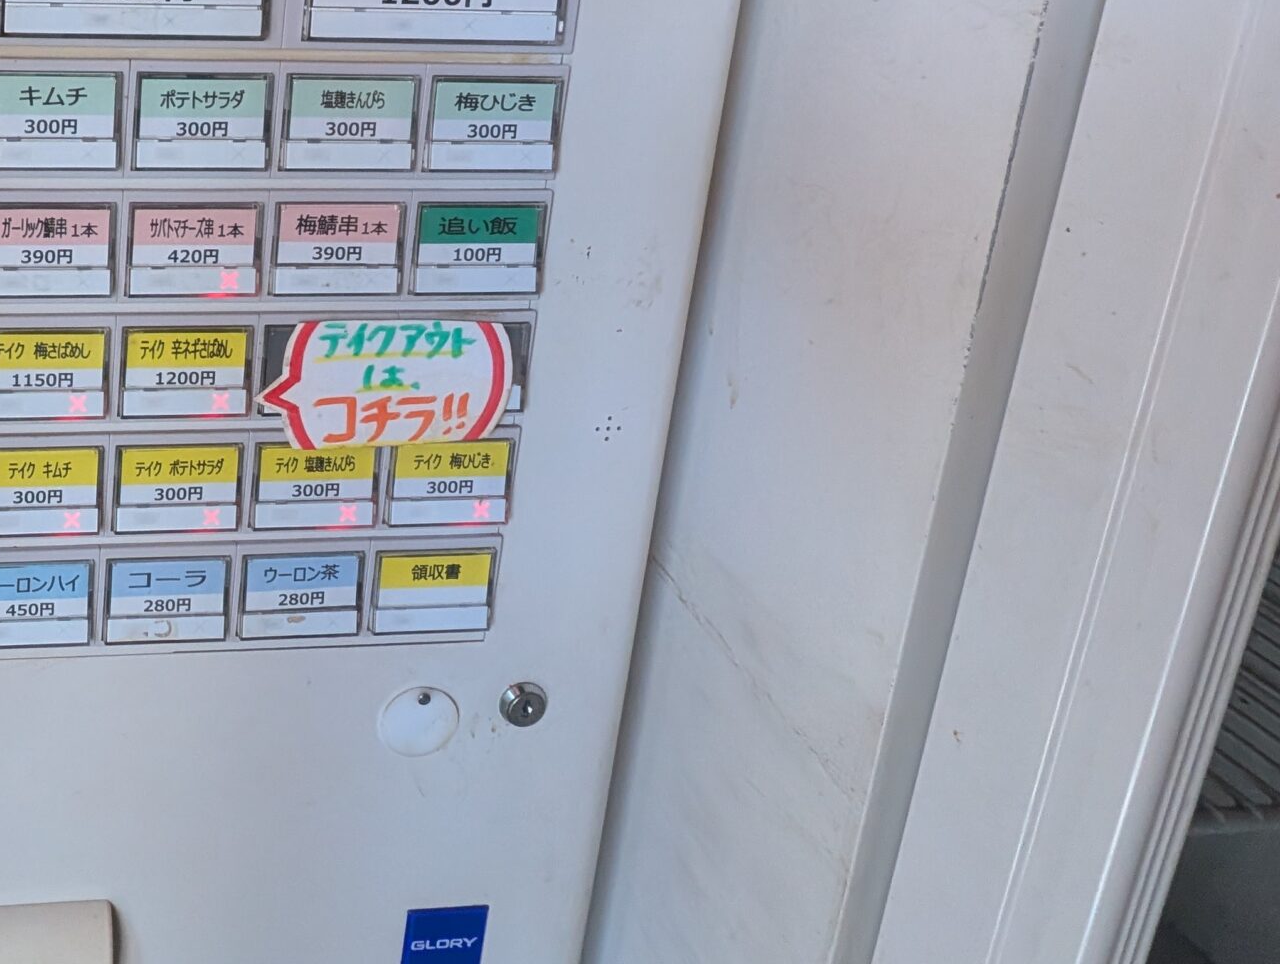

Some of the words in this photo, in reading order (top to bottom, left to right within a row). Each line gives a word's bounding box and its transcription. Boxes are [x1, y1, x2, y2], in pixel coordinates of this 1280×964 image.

[19, 85, 88, 107] キムチ
[160, 89, 246, 111] ポテトサラダ
[454, 92, 537, 113] 梅ひじき
[24, 119, 78, 135] 300円
[176, 121, 229, 138] 300円
[325, 121, 377, 138] 300円
[467, 123, 518, 140] 300円
[71, 222, 99, 238] 1本
[218, 222, 244, 238] 1本
[361, 220, 388, 235] 1本
[438, 215, 519, 237] 追い飯
[20, 248, 74, 265] 390円
[168, 248, 220, 264] 420円
[312, 245, 363, 262] 390円
[453, 246, 502, 263] 100円
[140, 339, 165, 360] テイク
[171, 337, 233, 359] 辛ネギさばめし
[319, 321, 477, 359] テイクアウト
[33, 341, 91, 361] 梅さばめし
[11, 371, 75, 389] 1150円
[155, 370, 216, 387] 1200円
[313, 392, 471, 443] コチラ!!
[8, 461, 36, 480] テイク
[43, 460, 73, 479] キムチ
[135, 460, 162, 478] テイク
[169, 457, 225, 477] ポテトサラダ
[275, 456, 299, 474] テイク
[413, 453, 442, 471] テイク
[449, 452, 492, 470] 梅ひじき
[154, 486, 203, 502] 300円
[292, 482, 340, 498] 300円
[426, 479, 474, 495] 300円
[13, 489, 63, 505] 300円
[128, 569, 208, 590] コーラ
[264, 563, 340, 584] ウーロン茶
[411, 563, 462, 582] 領収書
[143, 597, 192, 613] 280円
[278, 591, 325, 607] 280円
[5, 602, 55, 617] 450円
[411, 937, 478, 951] GLORY
